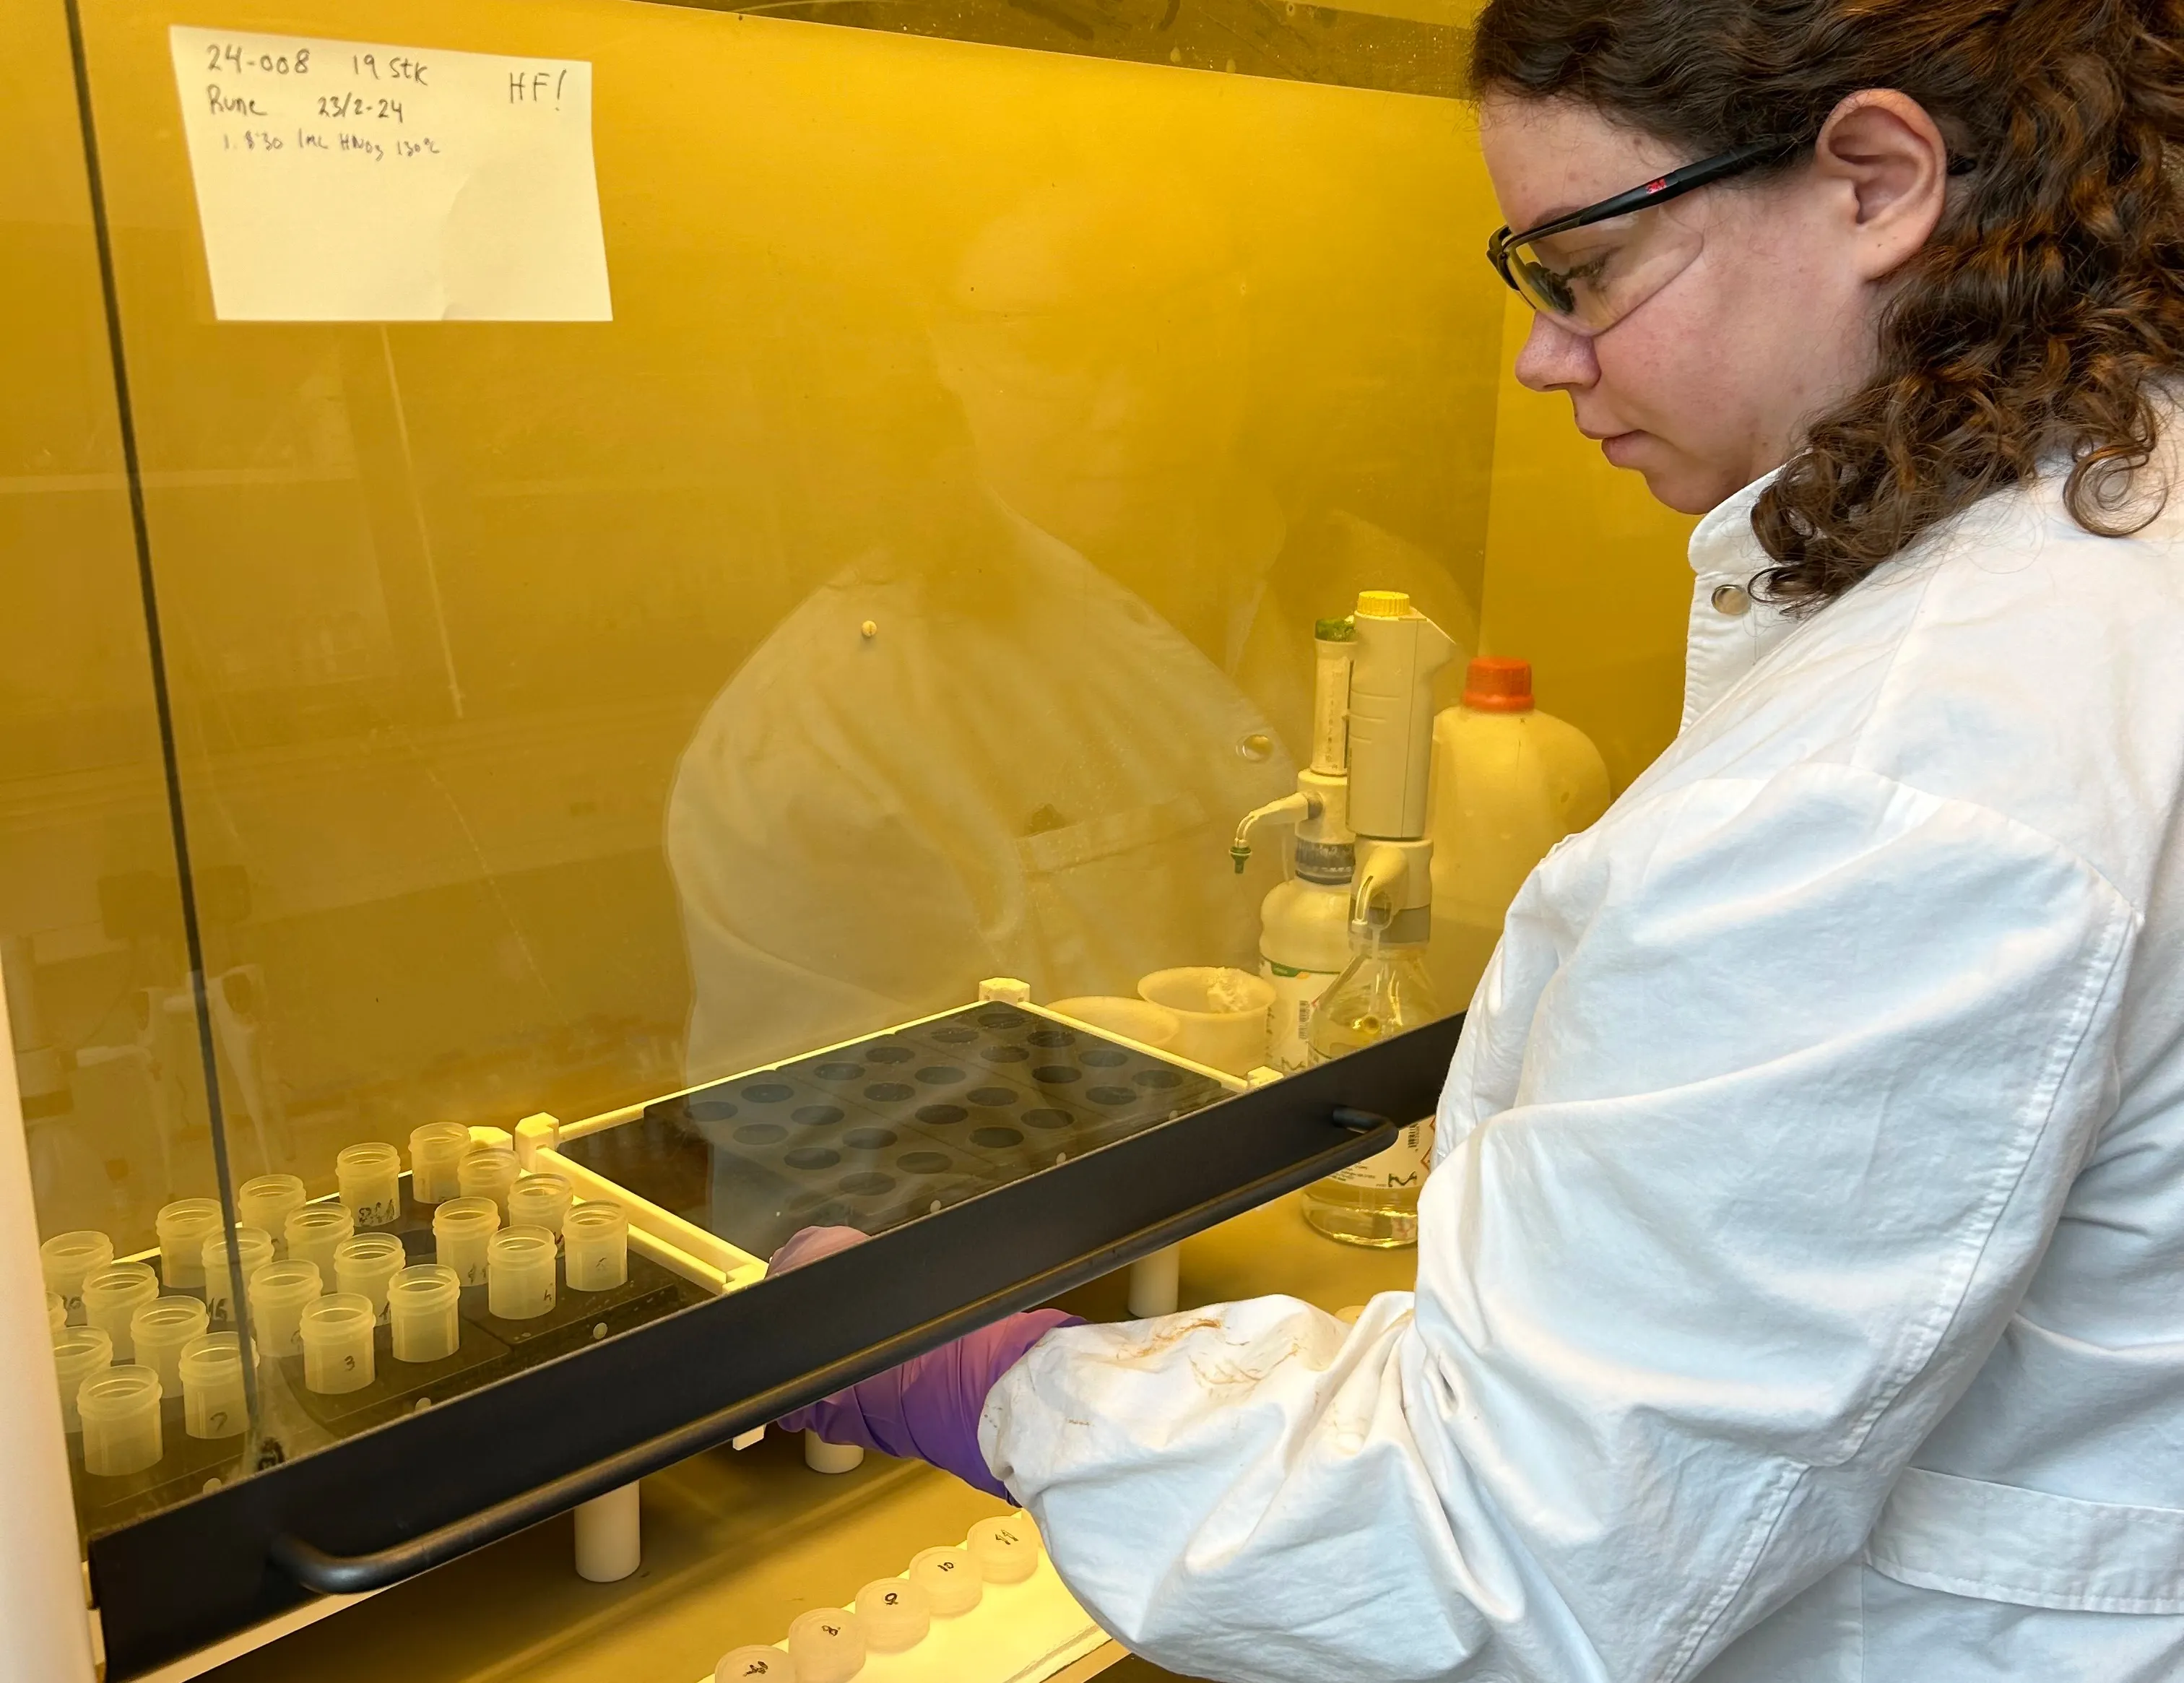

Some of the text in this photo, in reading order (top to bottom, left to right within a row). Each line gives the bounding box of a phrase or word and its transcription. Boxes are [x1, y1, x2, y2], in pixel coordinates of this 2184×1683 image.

[207, 43, 310, 74] 24-008
[353, 54, 380, 80] 19
[207, 84, 268, 116] Rune
[509, 69, 567, 111] HF!
[344, 1355, 355, 1371] 3
